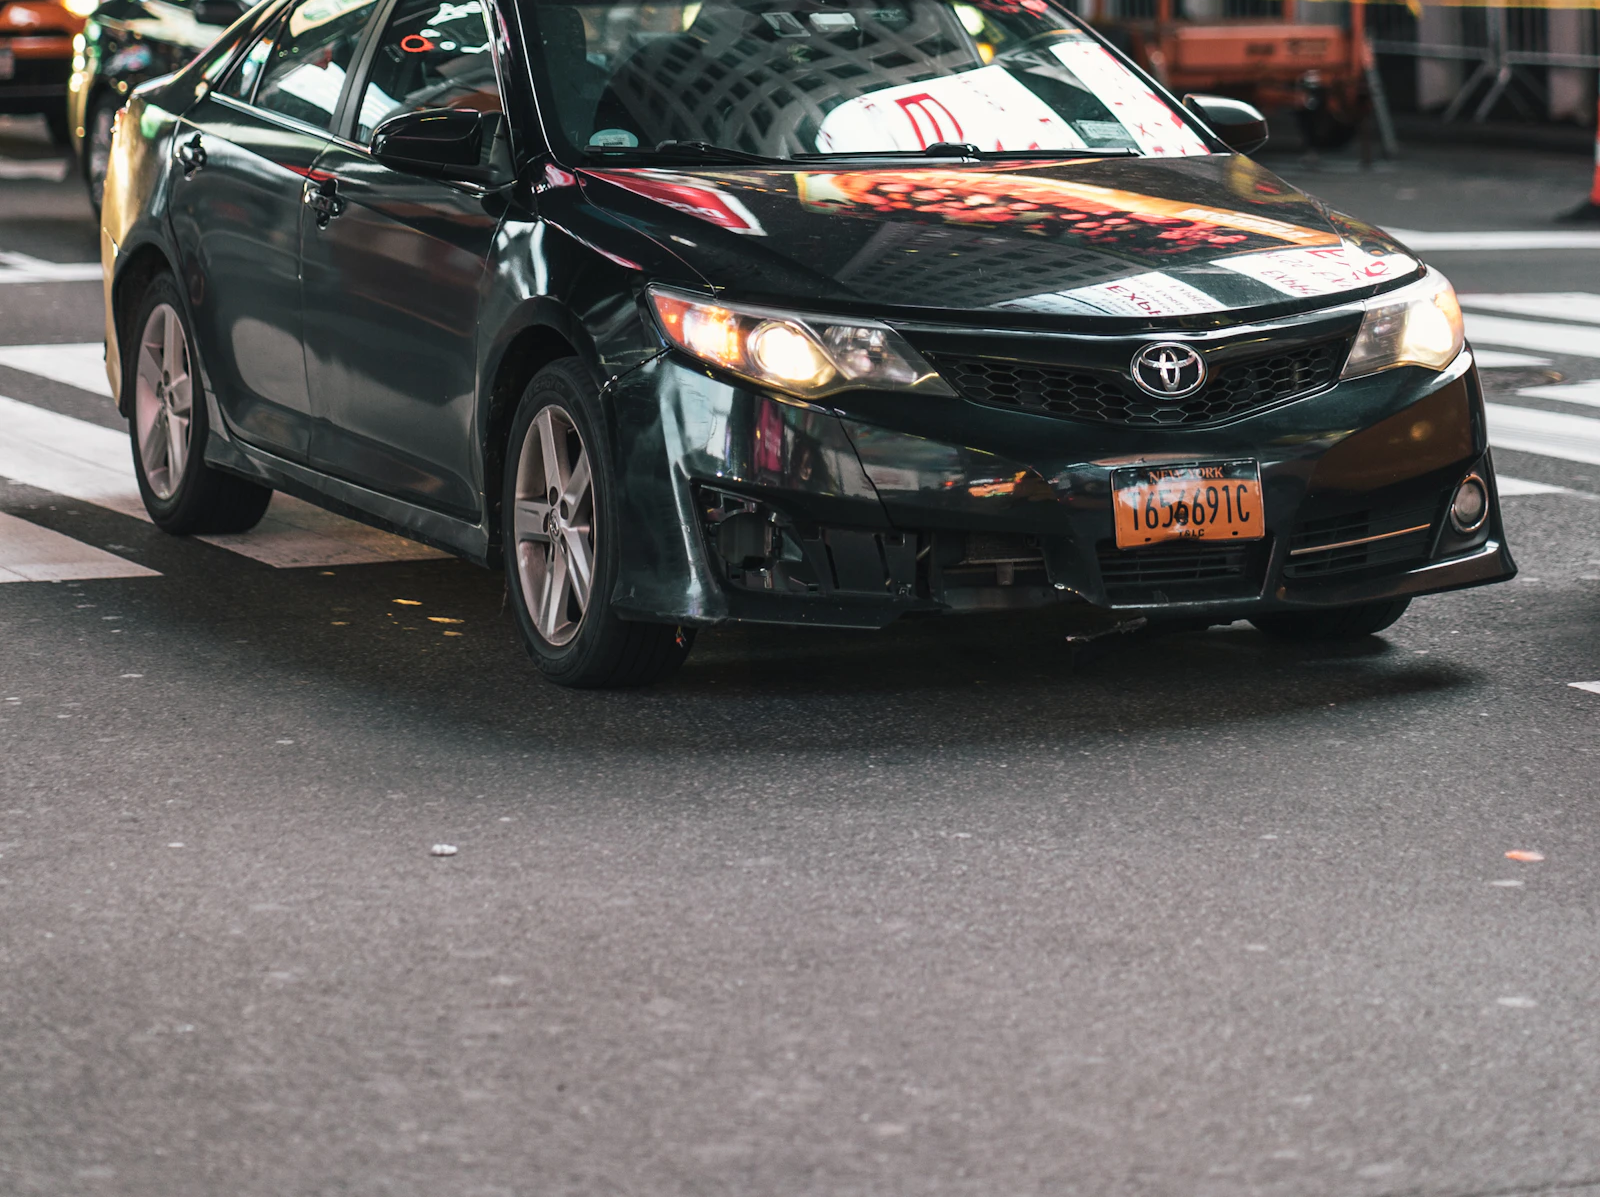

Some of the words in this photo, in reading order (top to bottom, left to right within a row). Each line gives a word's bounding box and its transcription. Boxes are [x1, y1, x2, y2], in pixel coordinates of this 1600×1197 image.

[1149, 469, 1182, 483] NEW
[1188, 466, 1224, 478] YORK
[1129, 484, 1250, 530] T656691C
